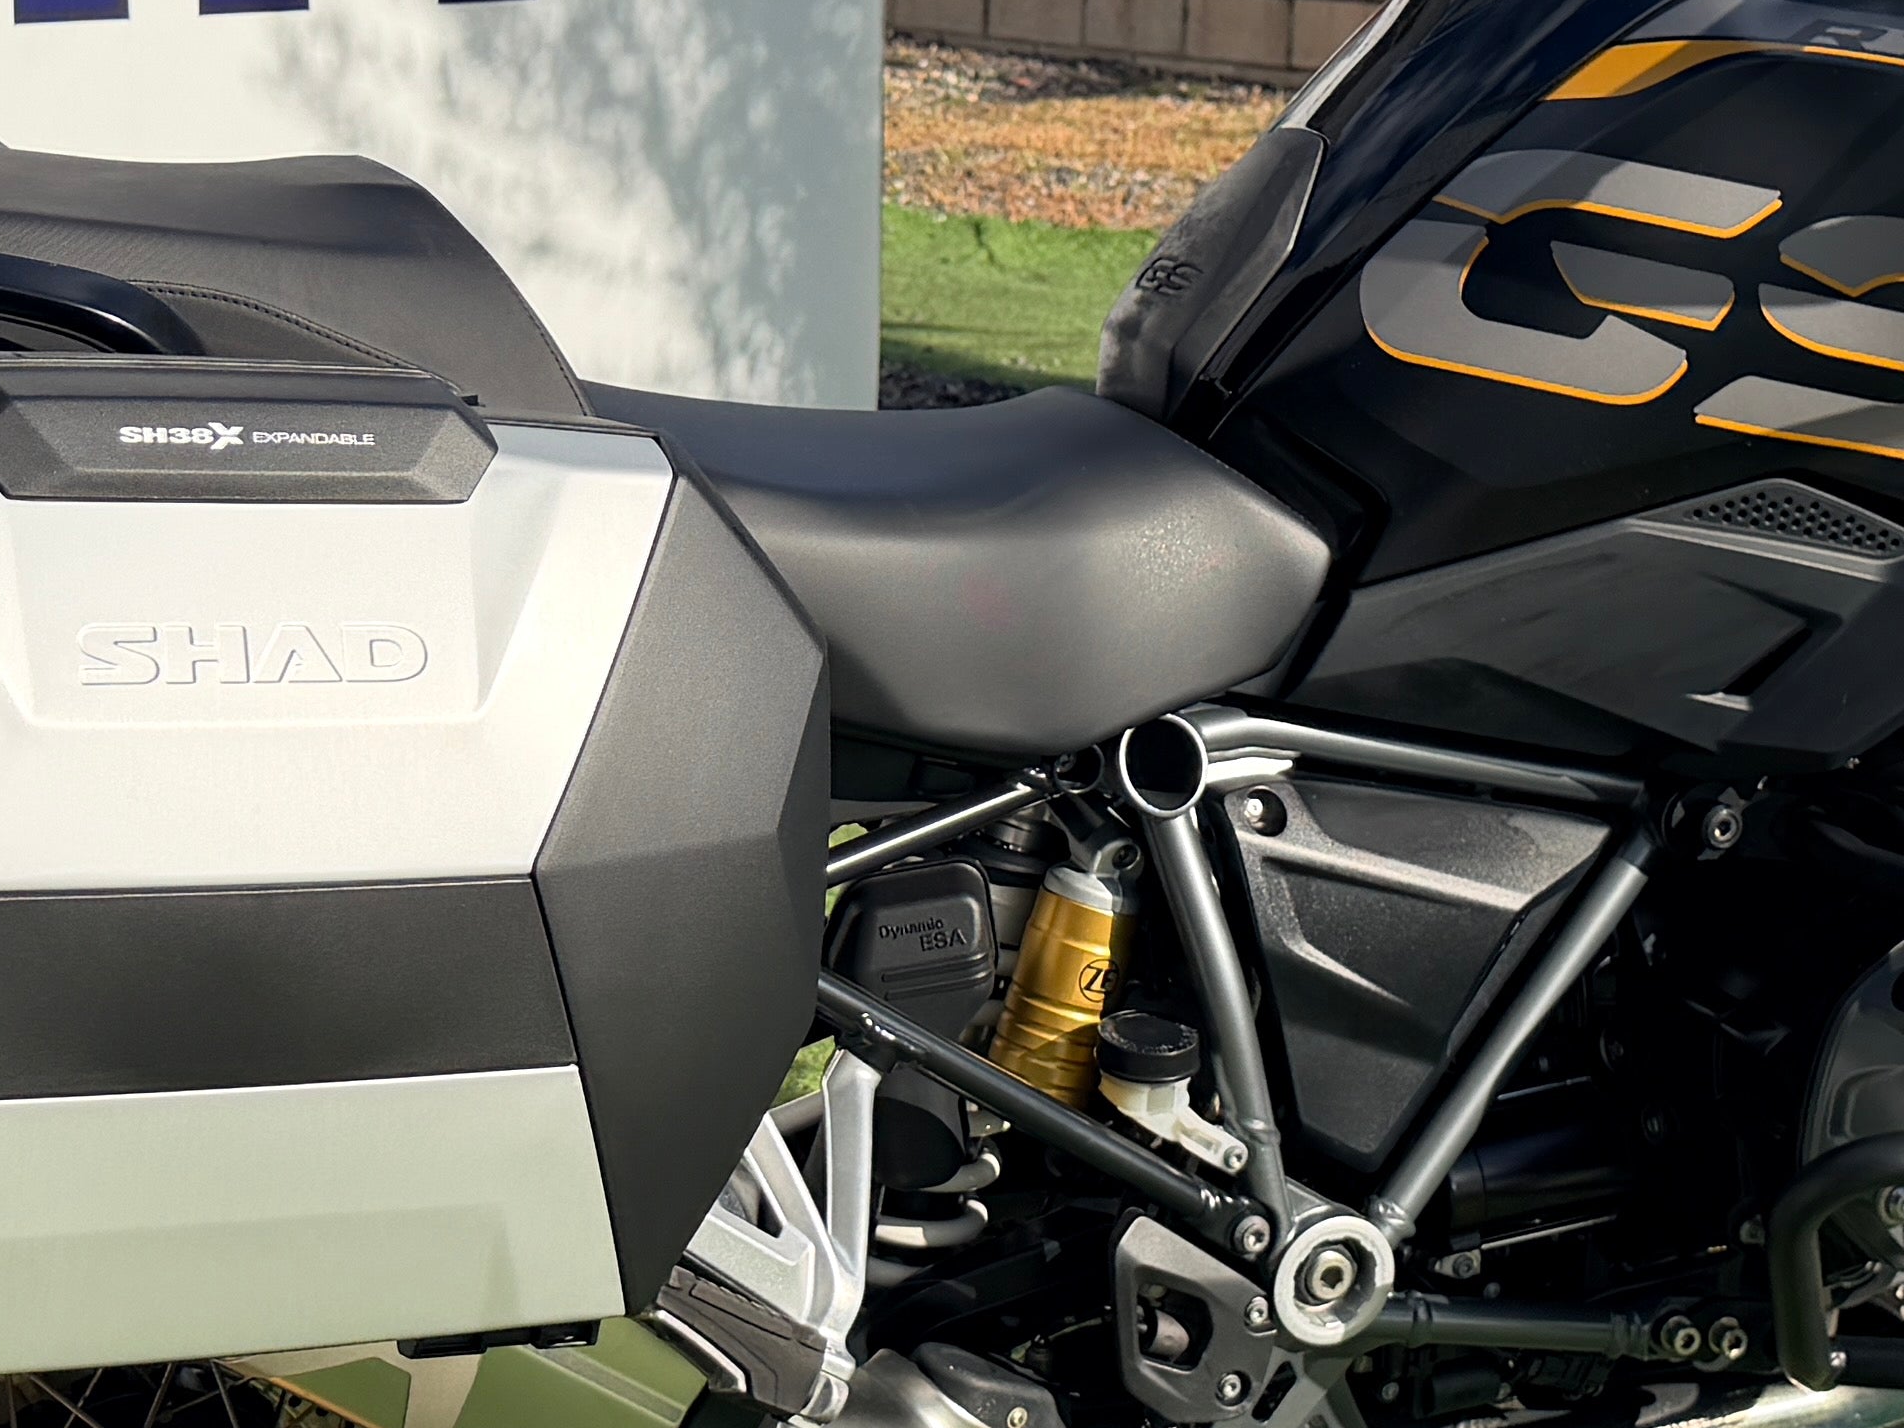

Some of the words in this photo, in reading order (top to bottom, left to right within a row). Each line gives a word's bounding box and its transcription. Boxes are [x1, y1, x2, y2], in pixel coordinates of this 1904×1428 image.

[119, 421, 245, 450] SH38X
[252, 430, 376, 446] EXPANDABLE
[76, 621, 429, 686] SHAD
[919, 927, 968, 953] ESA
